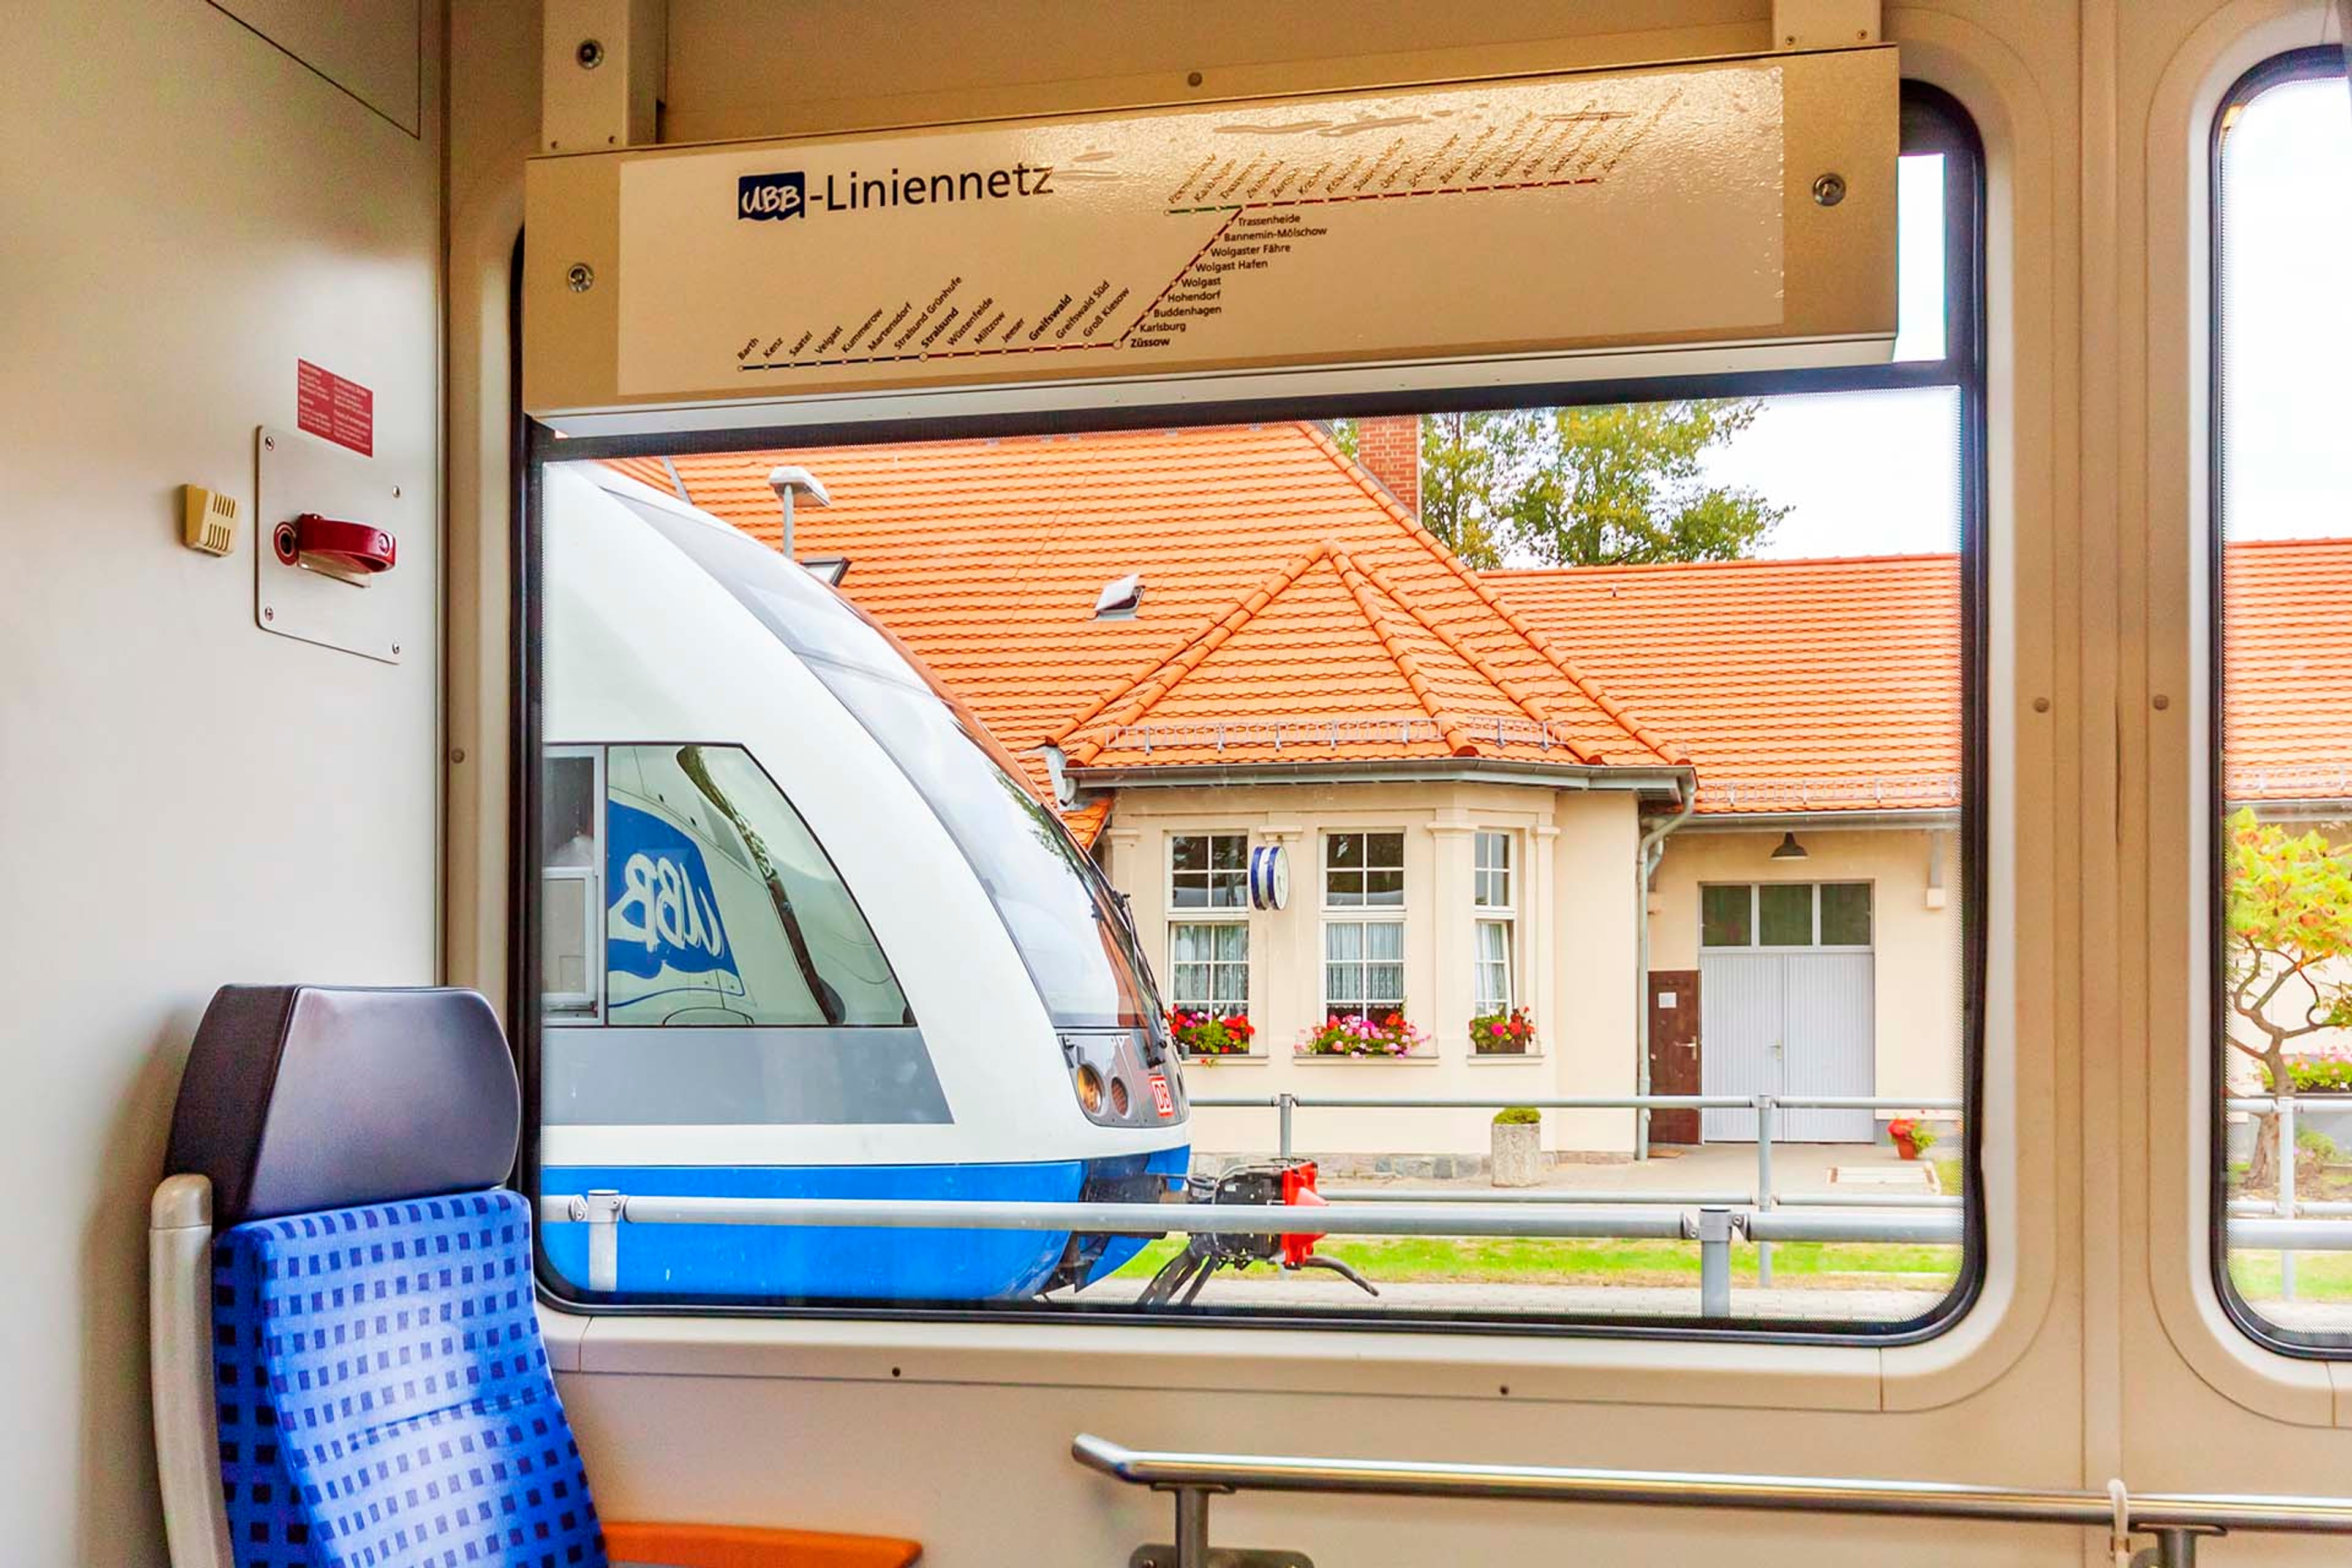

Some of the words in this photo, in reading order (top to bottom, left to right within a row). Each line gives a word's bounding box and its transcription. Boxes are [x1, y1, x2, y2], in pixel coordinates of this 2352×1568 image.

[1238, 214, 1300, 227] Trassenheide
[1225, 227, 1327, 242] Bannemin-Mölschow
[1210, 245, 1261, 257] Wolgaster
[1263, 244, 1291, 253] Fähre
[1196, 262, 1235, 273] Wolgast
[1238, 260, 1268, 270] Hafen
[1181, 277, 1221, 289] Wolgast
[1055, 296, 1096, 339] Greifswald
[1093, 279, 1110, 298] Süd
[1167, 290, 1221, 303] Hohendorf
[894, 312, 929, 350] Stralsund
[926, 276, 962, 314] Grünhufe
[1028, 293, 1072, 341] Greifswald
[1082, 315, 1103, 337] Groß
[1102, 287, 1130, 317] Kiesow
[1154, 306, 1222, 318] Buddenhagen
[841, 307, 883, 353] Kummerow
[867, 301, 913, 352] Martensdorf
[921, 306, 959, 349] Stralsund
[973, 311, 1006, 345] Miltzow
[1001, 317, 1025, 344] Jeeser
[1139, 322, 1186, 333] Karlsburg
[737, 337, 760, 361] Barth
[763, 337, 784, 358] Kenz
[789, 331, 813, 357] Saatel
[814, 325, 843, 355] Velgast
[1130, 337, 1170, 349] Züssow
